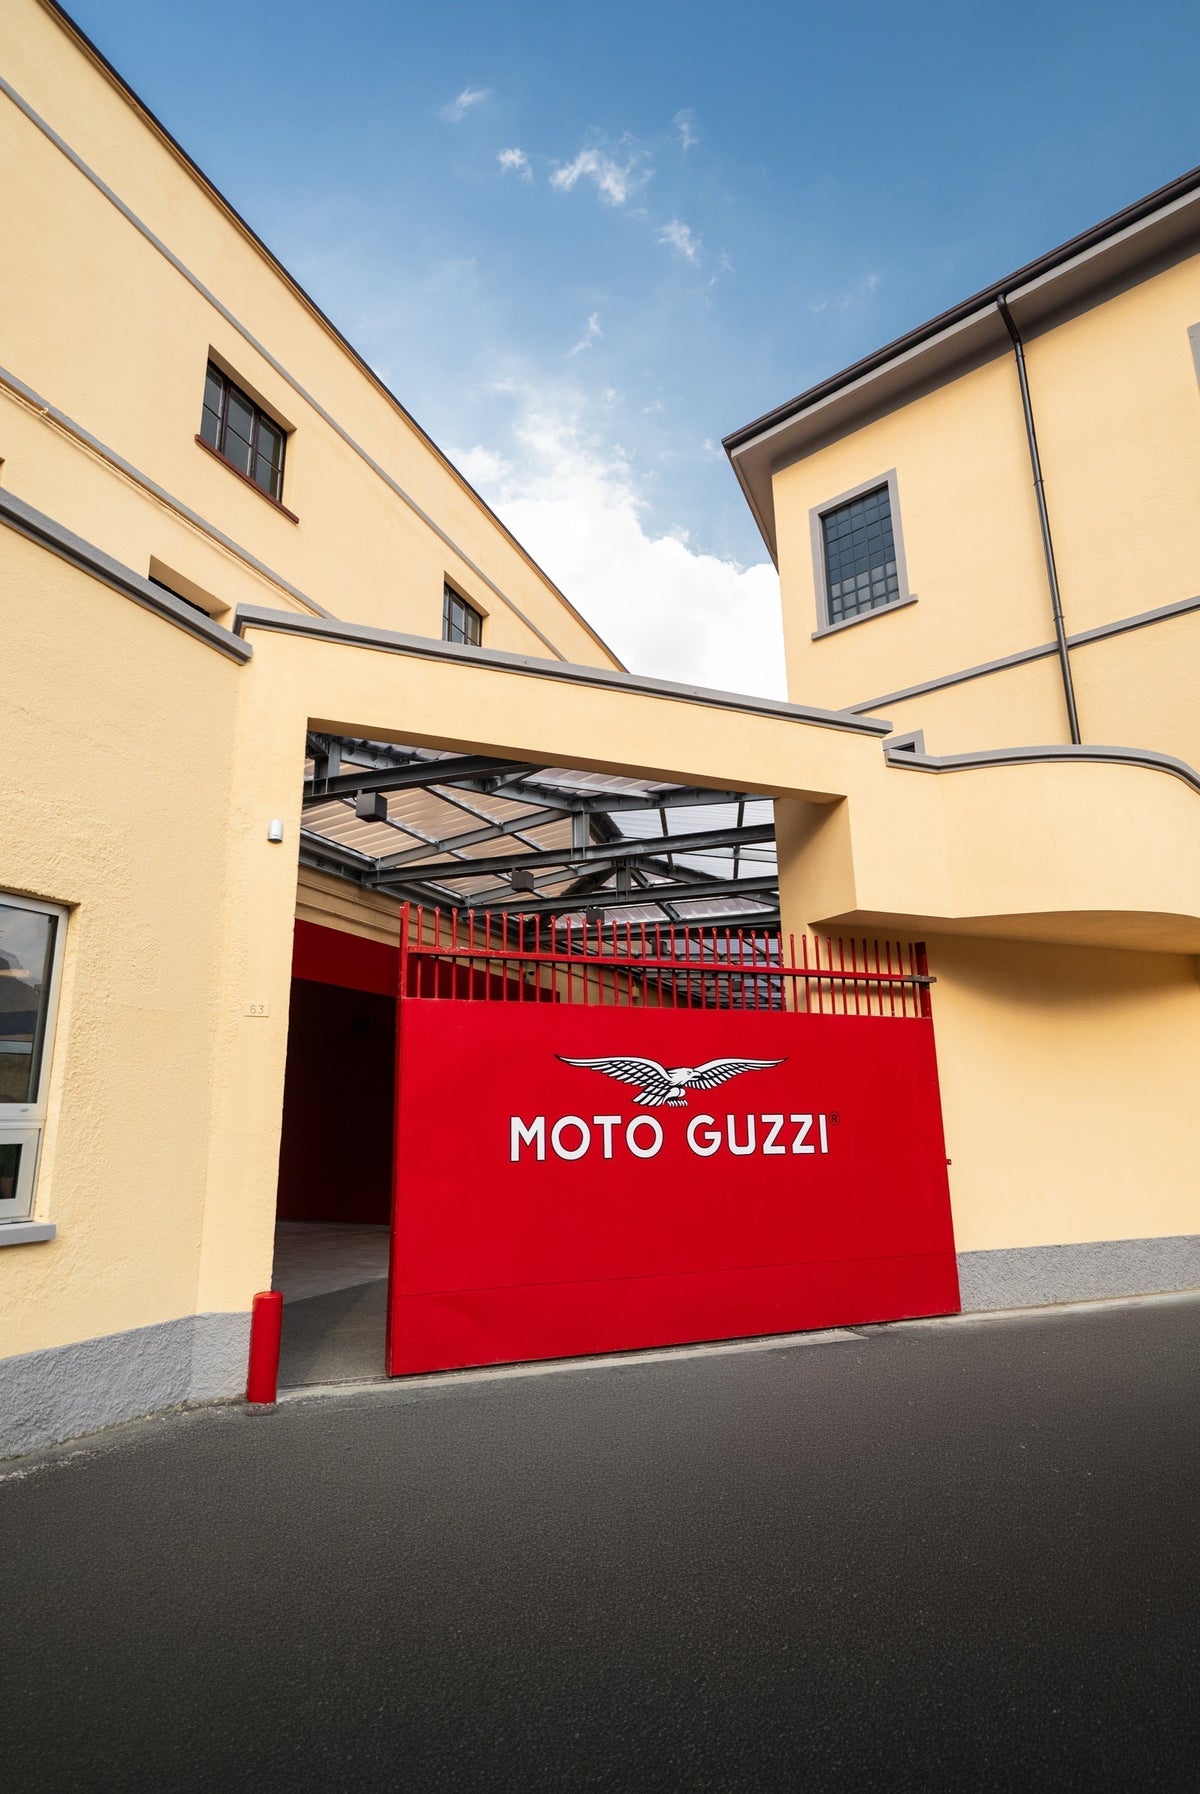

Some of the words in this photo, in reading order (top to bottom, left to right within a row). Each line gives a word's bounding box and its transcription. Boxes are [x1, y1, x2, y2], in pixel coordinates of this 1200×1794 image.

[250, 1004, 264, 1014] 63
[510, 1114, 664, 1162] MOTO
[686, 1113, 829, 1157] GUZZI
